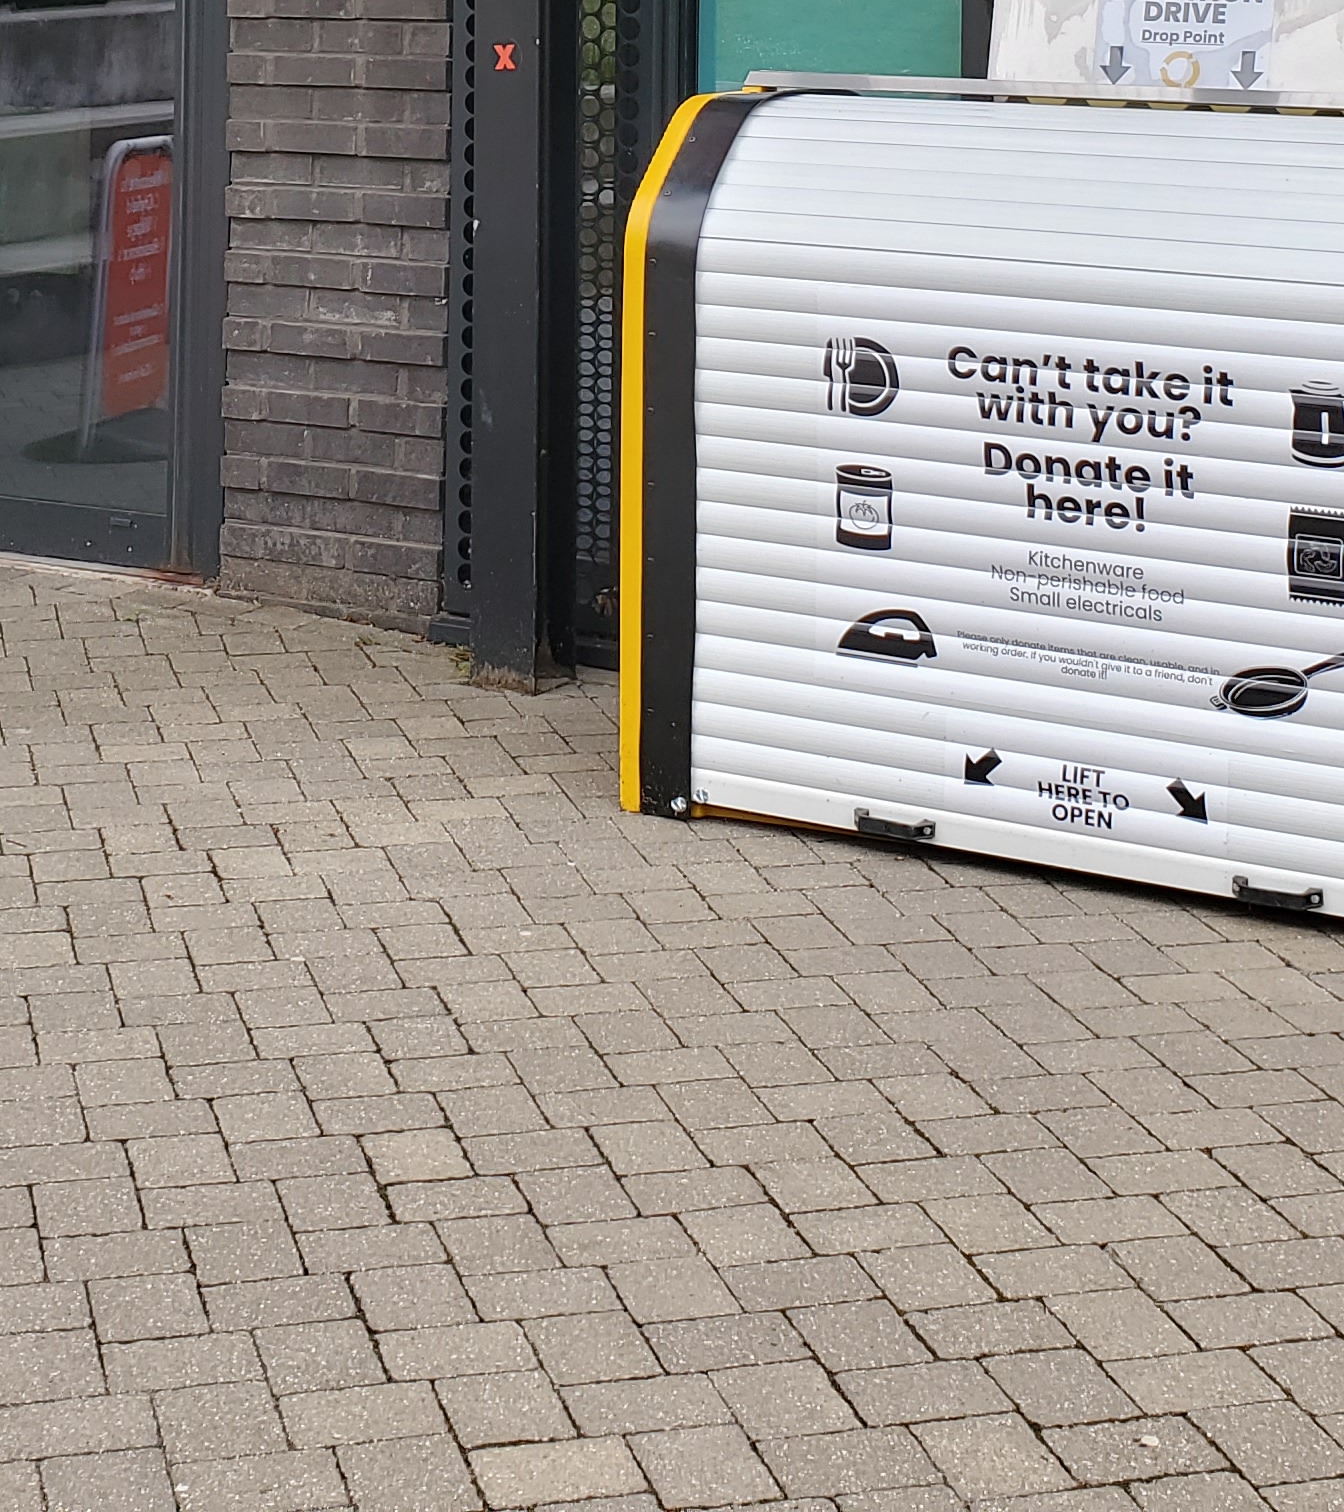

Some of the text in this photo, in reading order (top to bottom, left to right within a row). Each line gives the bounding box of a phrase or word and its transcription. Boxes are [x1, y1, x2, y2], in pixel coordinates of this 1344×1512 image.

[1143, 1, 1226, 25] DRIVE
[1141, 28, 1224, 46] Drop Point
[947, 345, 1234, 407] Can't take it
[976, 385, 1201, 443] with you?
[983, 441, 1194, 499] Donate it
[1026, 483, 1145, 532] here!
[1028, 550, 1144, 580] Kitchenware
[991, 564, 1185, 604] Non-perishable food
[1010, 586, 1162, 622] Small electricals
[956, 630, 988, 642] Please
[989, 636, 1009, 648] only
[1011, 639, 1045, 650] donate
[1047, 643, 1074, 654] items
[1076, 648, 1097, 657] that
[1099, 652, 1116, 661] are
[1187, 664, 1208, 674] and
[1210, 666, 1220, 676] in
[962, 642, 999, 657] working
[1038, 653, 1057, 663] you
[1058, 656, 1099, 669] wouldn't
[1101, 662, 1122, 673] give
[1124, 665, 1131, 674] it
[1133, 666, 1143, 676] to
[1145, 669, 1152, 677] a
[1154, 668, 1185, 683] friend,
[1187, 674, 1213, 686] don't
[1061, 665, 1096, 679] donate
[1062, 764, 1106, 788] LIFT
[1038, 781, 1130, 811] HERE TO
[1052, 804, 1113, 830] OPEN
